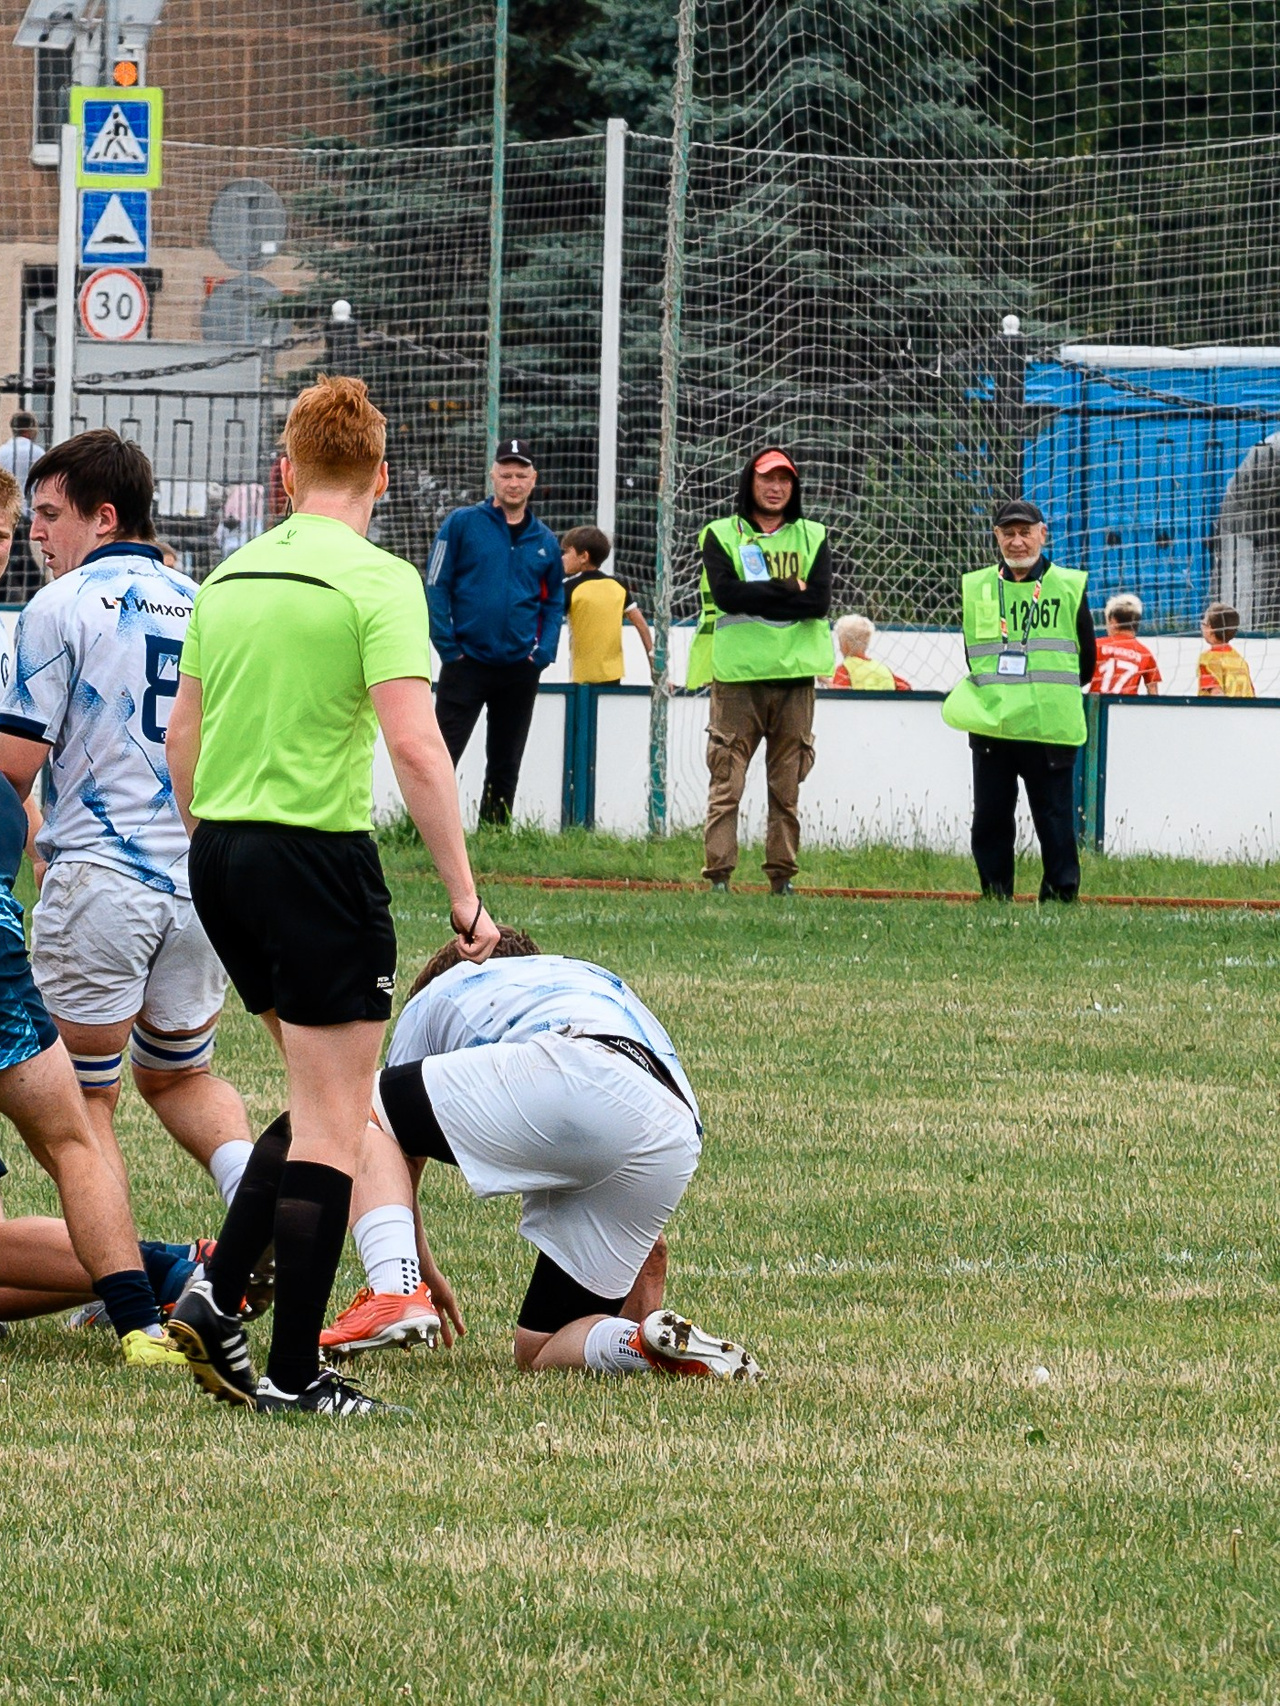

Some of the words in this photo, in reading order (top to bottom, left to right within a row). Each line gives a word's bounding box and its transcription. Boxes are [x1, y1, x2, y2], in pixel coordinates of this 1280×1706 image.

[95, 291, 133, 320] 30
[511, 440, 519, 453] 1
[1010, 598, 1060, 631] 12067
[142, 633, 184, 744] 8
[1099, 657, 1139, 693] 17
